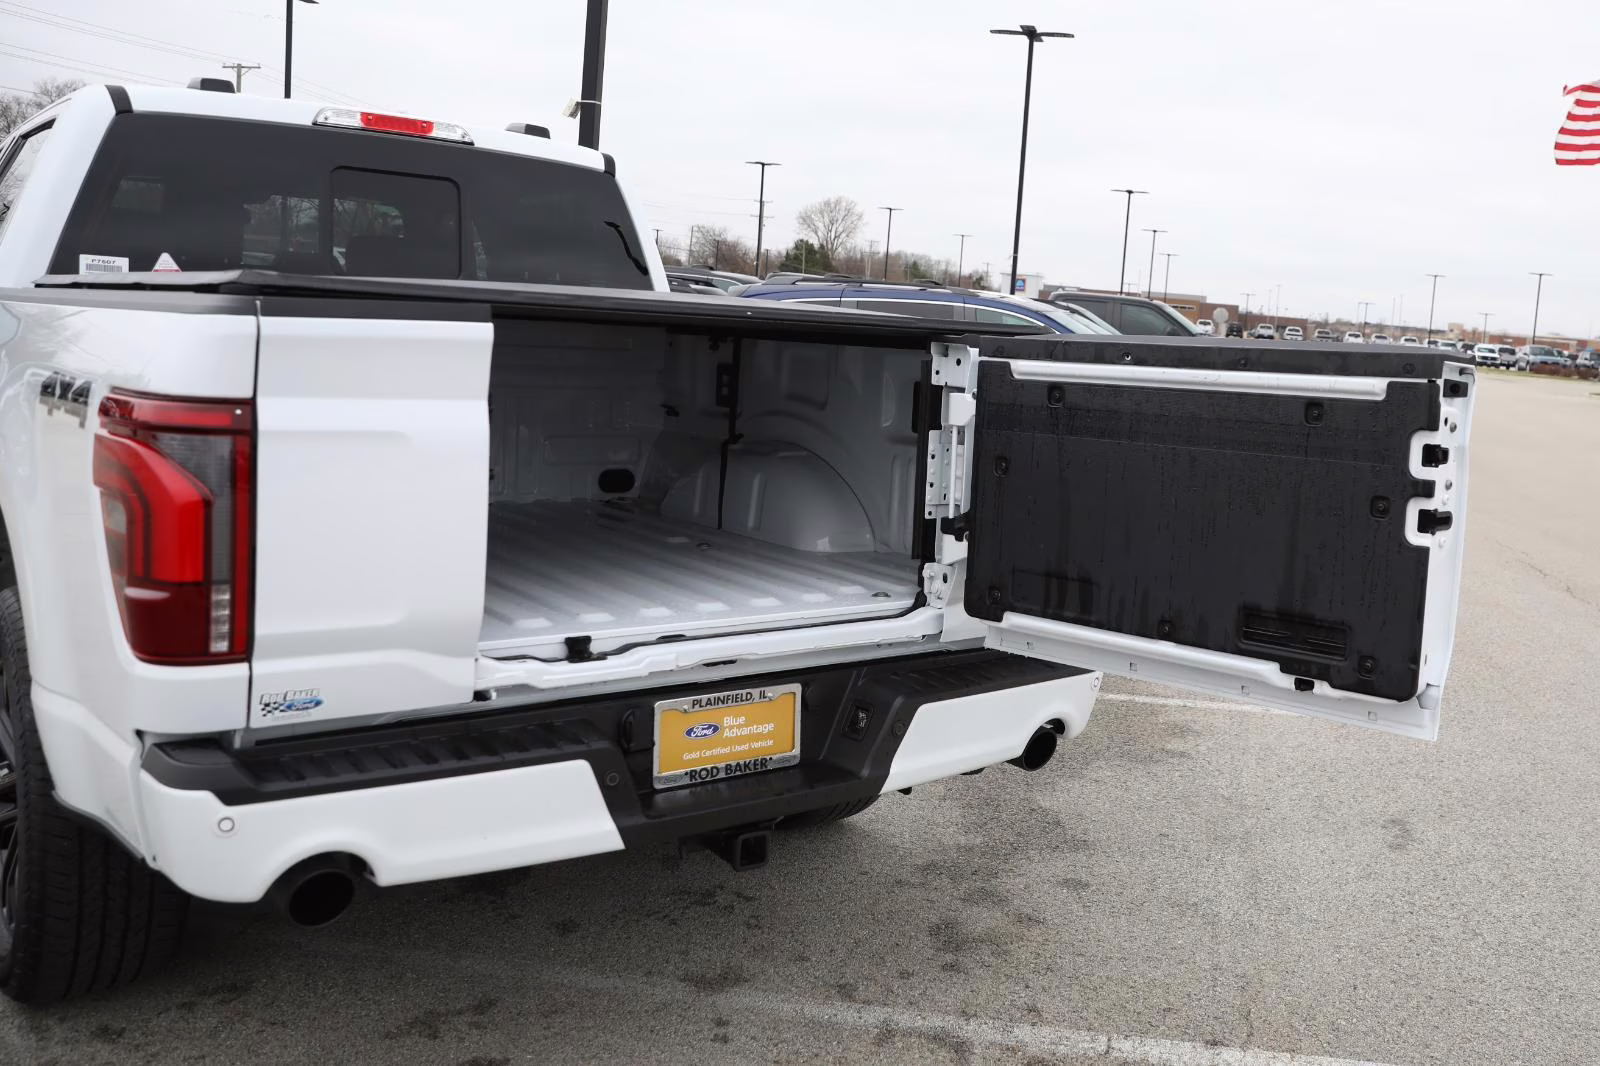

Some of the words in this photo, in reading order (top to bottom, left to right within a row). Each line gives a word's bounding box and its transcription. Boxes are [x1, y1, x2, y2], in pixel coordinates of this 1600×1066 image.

[692, 692, 755, 709] PLAINFIELD,
[758, 690, 768, 700] IL
[723, 716, 746, 726] Blue
[691, 725, 713, 738] Ford
[723, 722, 775, 738] Advantage
[683, 750, 700, 760] Gold
[702, 747, 730, 758] Certified
[732, 744, 749, 752] Used
[750, 739, 774, 748] Vehicle
